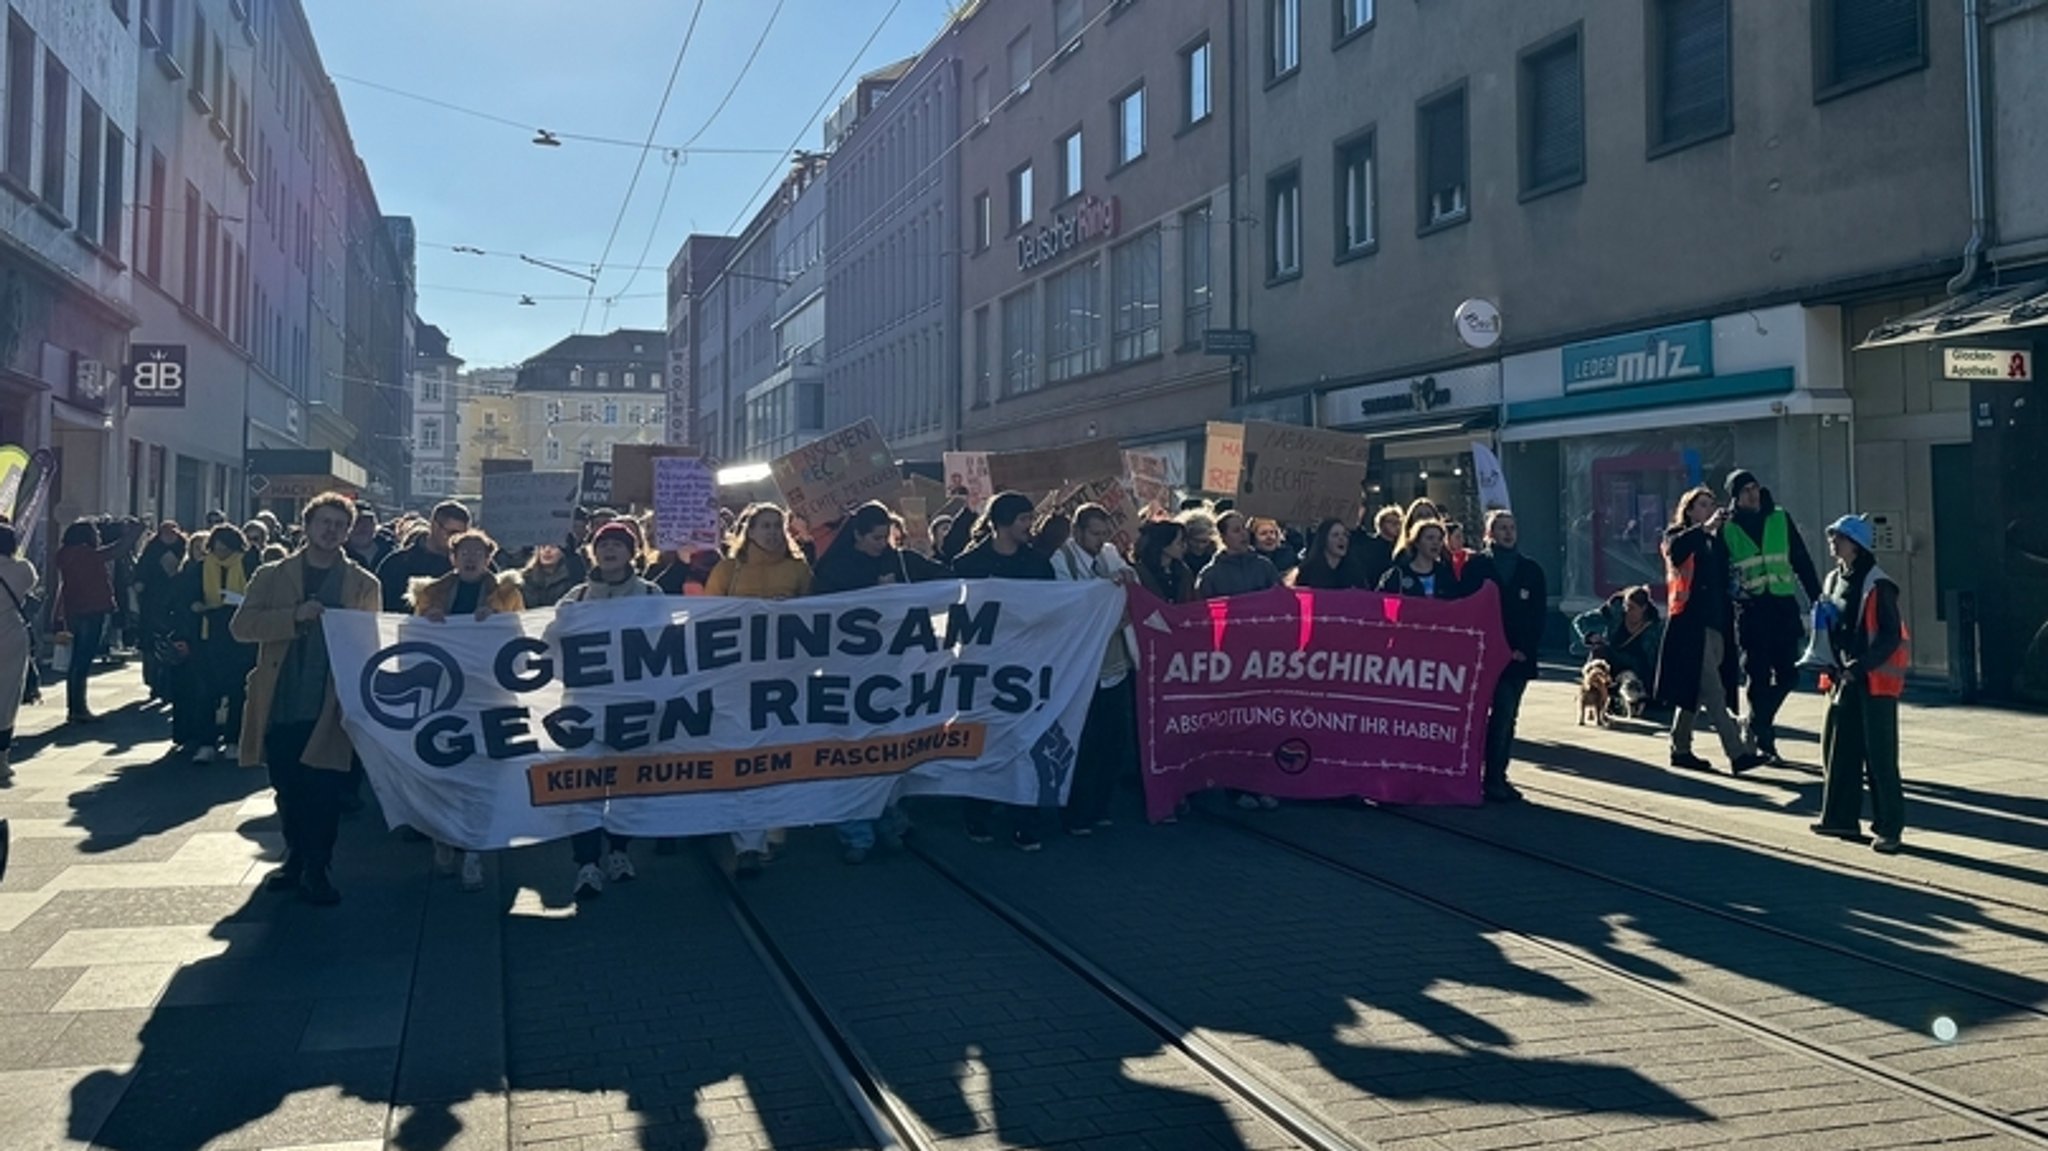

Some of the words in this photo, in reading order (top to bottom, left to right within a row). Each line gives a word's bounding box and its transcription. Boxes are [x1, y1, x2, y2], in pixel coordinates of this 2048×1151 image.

[1017, 213, 1078, 271] Deutscher
[1077, 196, 1115, 241] Ring
[1574, 355, 1616, 380] LEDER
[1613, 340, 1701, 385] milz
[1952, 347, 1996, 361] Glocken-
[1952, 364, 1999, 377] Apotheke
[1259, 465, 1318, 493] RECHTE
[494, 600, 1001, 694] GEMEINSAM
[1163, 650, 1231, 683] AFD
[1240, 650, 1466, 694] ABSCHIRMEN
[414, 688, 714, 768] GEGEN
[749, 664, 1052, 731] RECHTS!
[1164, 707, 1287, 735] ABSCHOTTUNG
[1289, 706, 1358, 731] KÖNNT
[1359, 716, 1389, 736] IHR
[1394, 721, 1457, 743] HABEN!
[547, 765, 617, 792] KEINE
[637, 760, 714, 784] RUHE
[734, 751, 792, 778] DEM
[815, 729, 970, 765] FASCHISMUS!
